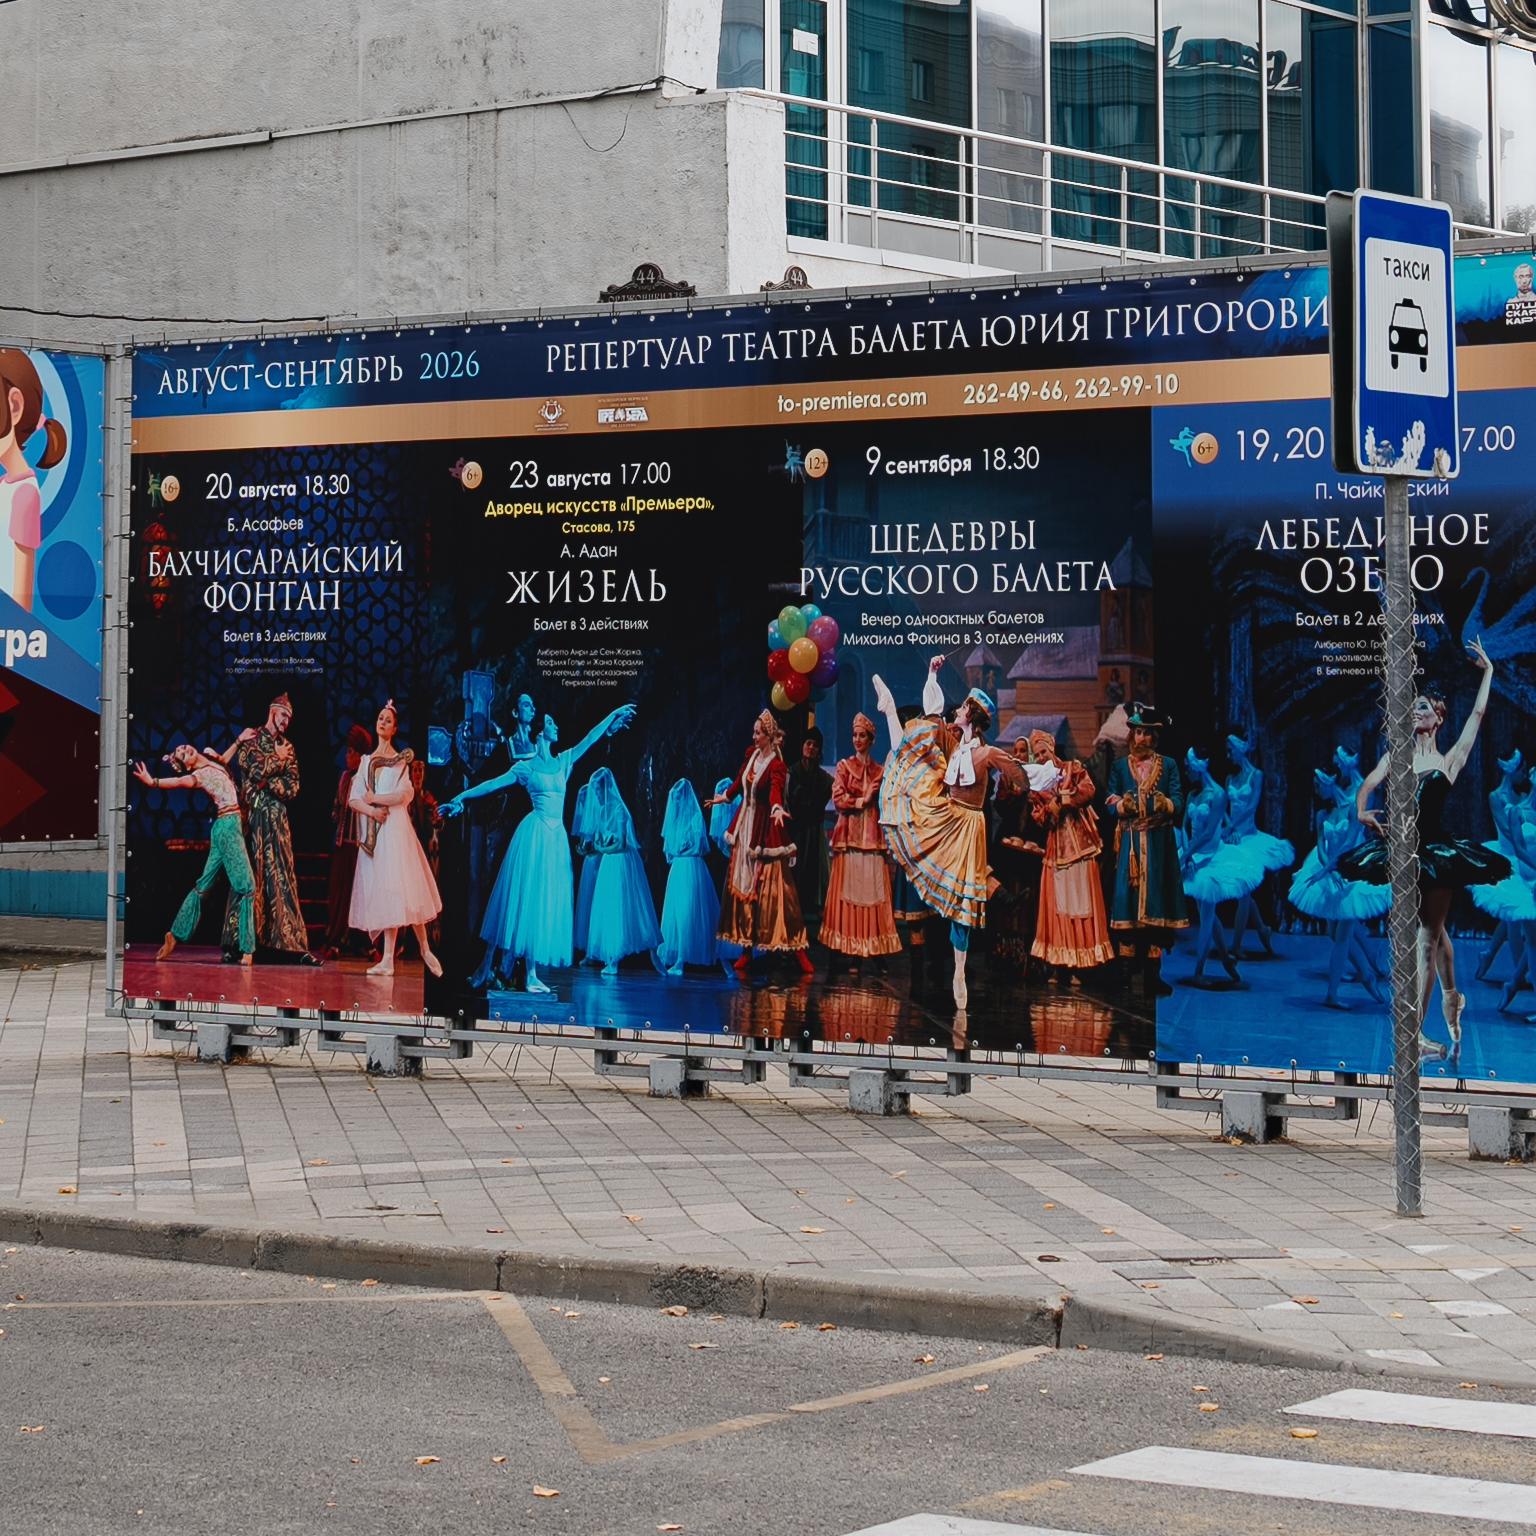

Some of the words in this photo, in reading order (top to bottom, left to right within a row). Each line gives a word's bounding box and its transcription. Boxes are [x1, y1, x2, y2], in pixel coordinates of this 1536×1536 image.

[636, 269, 656, 284] 44
[790, 269, 804, 285] 44
[1383, 256, 1431, 282] такси
[546, 335, 713, 373] РЕПЕРТУАР
[721, 327, 838, 363] ТЕАТРА
[849, 318, 971, 357] БАЛЕТА
[980, 310, 1091, 348] ЮРИЯ
[1104, 295, 1330, 340] ГРИГОРОВИ
[157, 354, 404, 395] АВГУСТ-СЕНТЯБРЬ
[419, 350, 480, 380] 2026
[777, 390, 928, 415] to-premiera.com
[963, 382, 1070, 407] 262-49-66,
[1074, 374, 1179, 399] 262-99-10
[1196, 441, 1214, 455] 6+
[1236, 428, 1280, 463] 19,
[1286, 425, 1325, 460] 20
[1461, 425, 1516, 453] 7.00
[807, 456, 828, 470] 12+
[866, 446, 881, 476] 9
[885, 454, 972, 476] сентября
[982, 446, 1040, 471] 18.30
[466, 468, 479, 481] 6+
[509, 460, 539, 489] 23
[546, 470, 611, 490] августа
[620, 461, 671, 485] 17.00
[205, 472, 232, 500] 20
[238, 482, 296, 500] августа
[304, 474, 350, 496] 18.30
[1315, 482, 1334, 500] П.
[1337, 478, 1450, 500] Чайкский
[484, 499, 544, 518] Дворец
[546, 497, 617, 516] искусств
[620, 495, 715, 513] «Премьера»,
[227, 518, 239, 532] Б.
[242, 516, 304, 534] Асафьев
[562, 521, 614, 534] Стасова,
[617, 520, 636, 532] 175
[869, 519, 1037, 555] ШЕДЕВРЫ
[148, 539, 404, 577] БАХЧИСАРАЙСКИЙ
[560, 543, 575, 559] А.
[579, 543, 618, 559] Адан
[799, 562, 979, 600] РУССКОГО
[991, 560, 1117, 594] БАЛЕТА
[1300, 553, 1445, 594] ОЗЕО
[203, 580, 342, 613] ФОНТАН
[505, 568, 667, 604] ЖИЗЕЛЬ
[533, 617, 567, 631] Балет
[570, 620, 577, 630] в
[579, 617, 587, 631] 3
[589, 617, 649, 631] действиях
[861, 612, 902, 628] Вечер
[904, 612, 985, 628] одноактных
[987, 610, 1045, 625] балетов
[1295, 612, 1339, 627] Балет
[1343, 615, 1351, 626] в
[1354, 611, 1364, 626] 2
[1366, 613, 1445, 627] девиях
[223, 629, 254, 642] Балет
[256, 632, 262, 641] в
[264, 629, 271, 642] 3
[273, 629, 327, 642] действиях
[842, 631, 904, 646] Михаила
[907, 630, 961, 646] Фокина
[964, 633, 971, 644] в
[973, 630, 983, 645] 3
[985, 631, 1065, 646] отделениях
[1314, 639, 1356, 650] Либретто
[1322, 654, 1333, 663] по
[1335, 654, 1373, 663] мотивам
